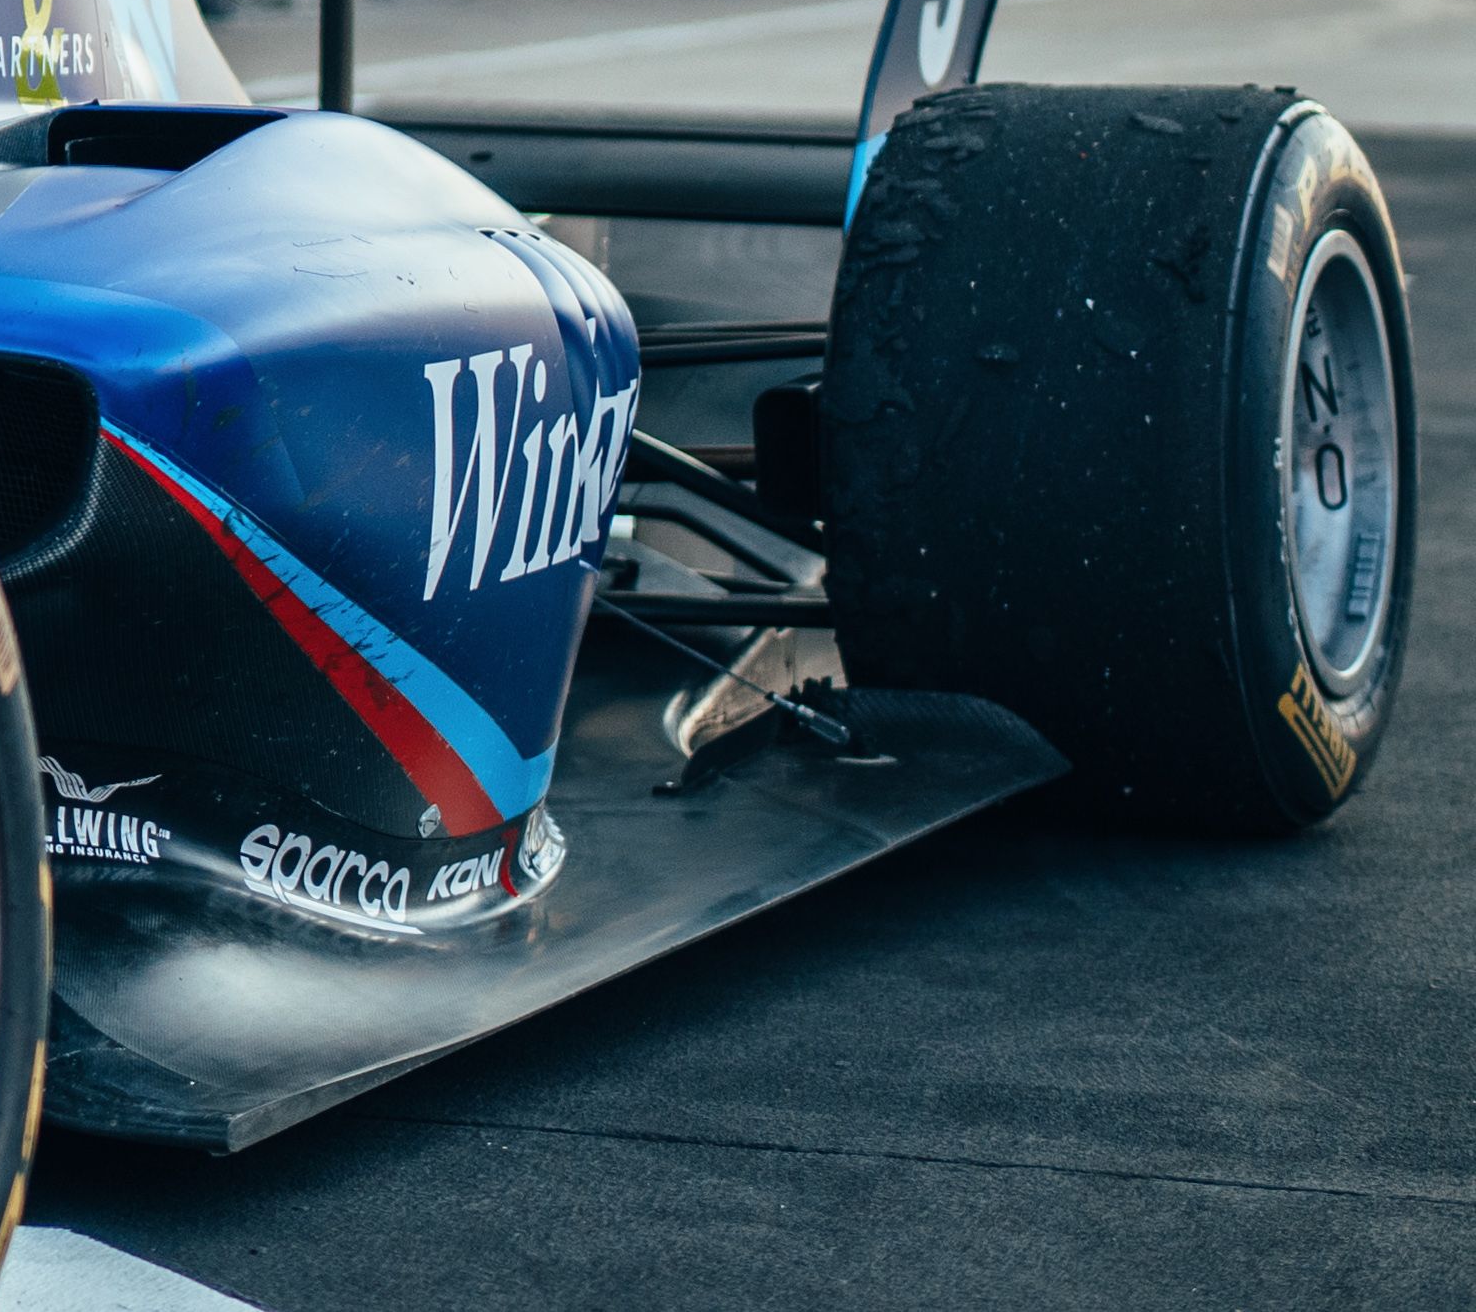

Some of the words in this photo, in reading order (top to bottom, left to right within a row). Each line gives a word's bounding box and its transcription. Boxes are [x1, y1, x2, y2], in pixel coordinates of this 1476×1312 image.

[70, 844, 150, 865] INSURANCE
[239, 823, 410, 924] sparco
[425, 847, 506, 902] KONI
